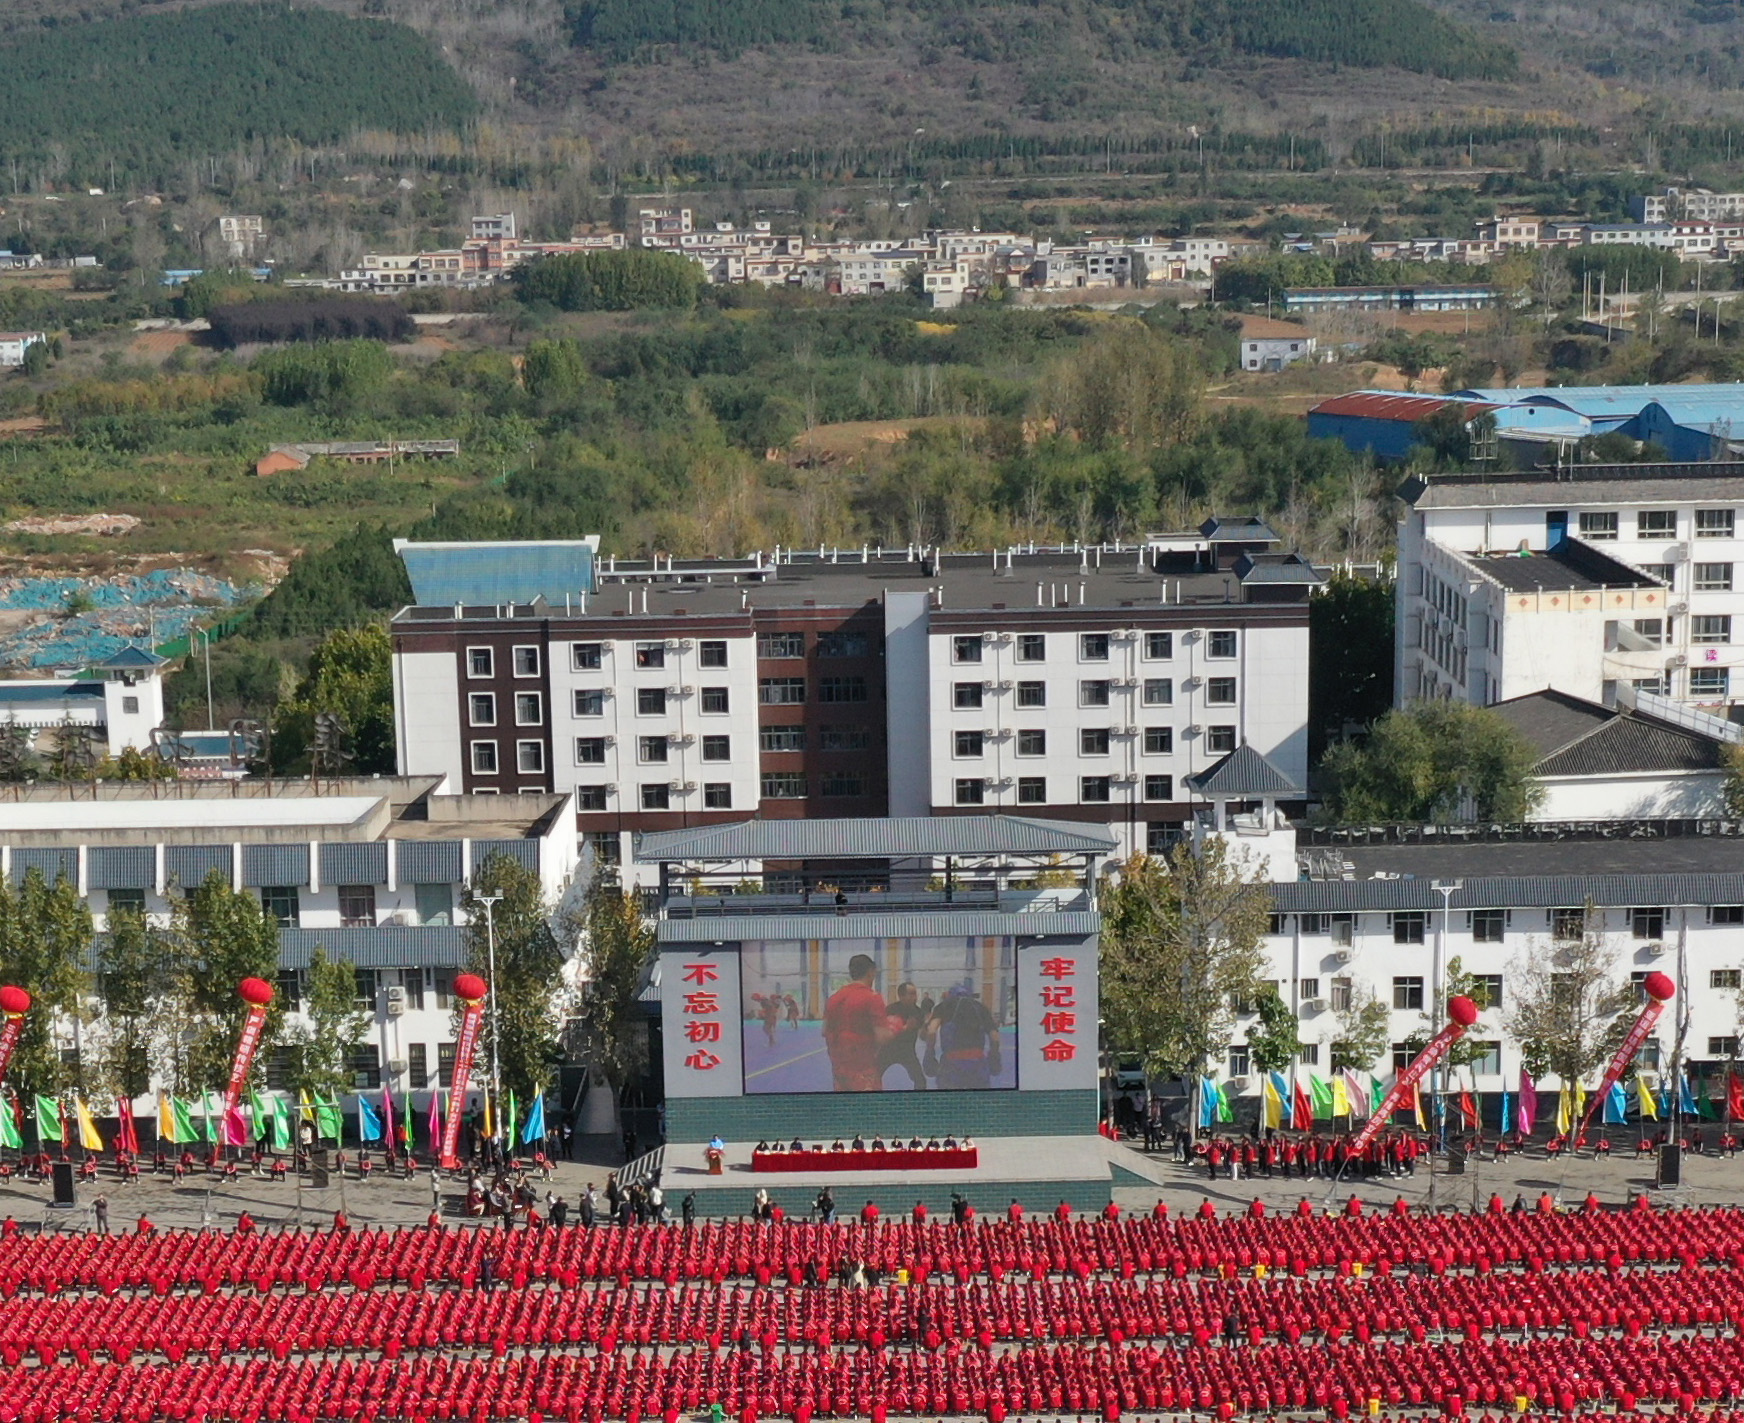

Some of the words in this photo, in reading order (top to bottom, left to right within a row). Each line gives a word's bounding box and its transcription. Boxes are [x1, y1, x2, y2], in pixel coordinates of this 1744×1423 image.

[682, 964, 722, 1070] 不忘初心
[1038, 956, 1077, 1062] 牢记使命
